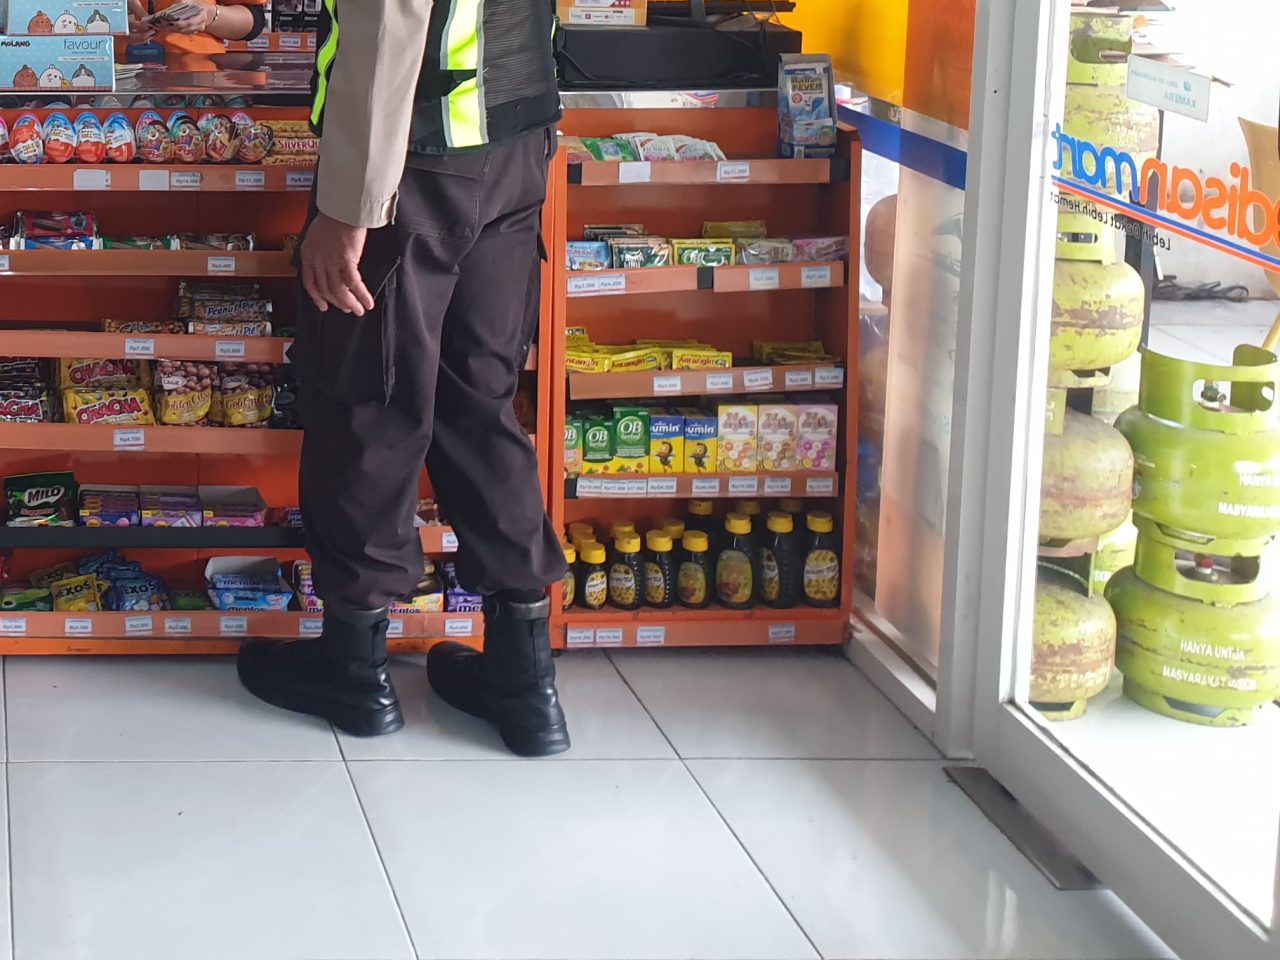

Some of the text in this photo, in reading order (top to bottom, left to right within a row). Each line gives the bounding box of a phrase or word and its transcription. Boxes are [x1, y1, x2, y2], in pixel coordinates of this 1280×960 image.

[63, 38, 102, 50] favour
[242, 301, 255, 311] Pie
[679, 355, 714, 365] Antangin
[76, 397, 143, 424] CHACHA
[620, 420, 642, 434] OB
[588, 431, 607, 443] OB
[27, 487, 61, 504] MILO
[1181, 639, 1213, 656] HANYA
